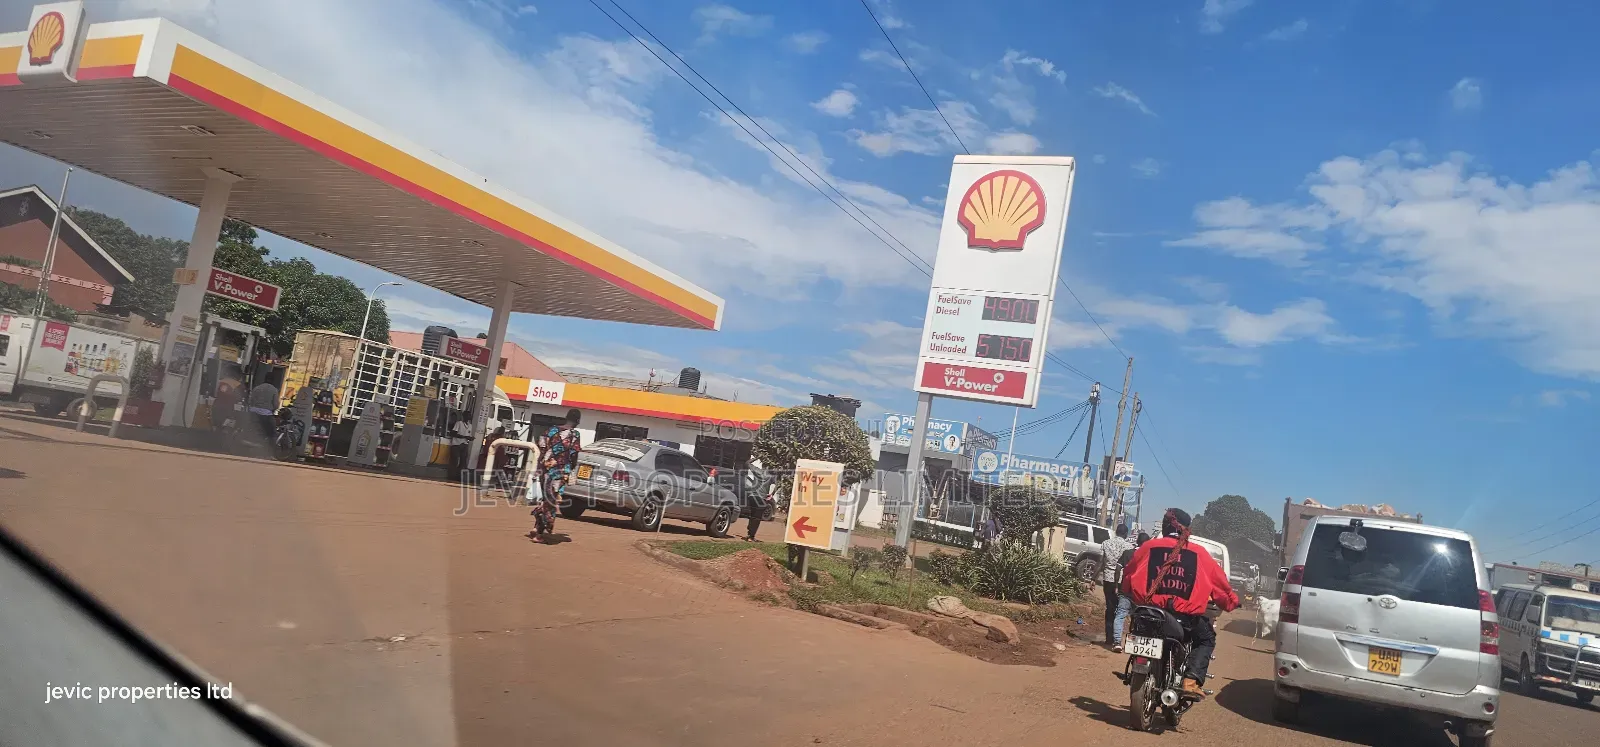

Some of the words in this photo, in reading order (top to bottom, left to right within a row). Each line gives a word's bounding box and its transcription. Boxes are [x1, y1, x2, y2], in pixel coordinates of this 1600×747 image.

[215, 273, 233, 283] Shell
[214, 281, 258, 301] V-Power
[937, 295, 972, 306] FuelSave
[935, 306, 960, 316] Diesel
[985, 297, 1039, 323] 4900
[931, 332, 965, 343] FuelSave
[450, 341, 463, 349] Shell
[450, 347, 478, 361] V-Power
[944, 367, 966, 377] Shell
[943, 376, 998, 393] V-Power
[532, 386, 558, 401] Shop
[902, 416, 953, 432] Phmacy
[1000, 454, 1078, 478] Pharmacy
[800, 471, 825, 486] Way
[798, 483, 807, 493] In
[1378, 651, 1400, 662] UAU
[1371, 660, 1398, 673] 729W
